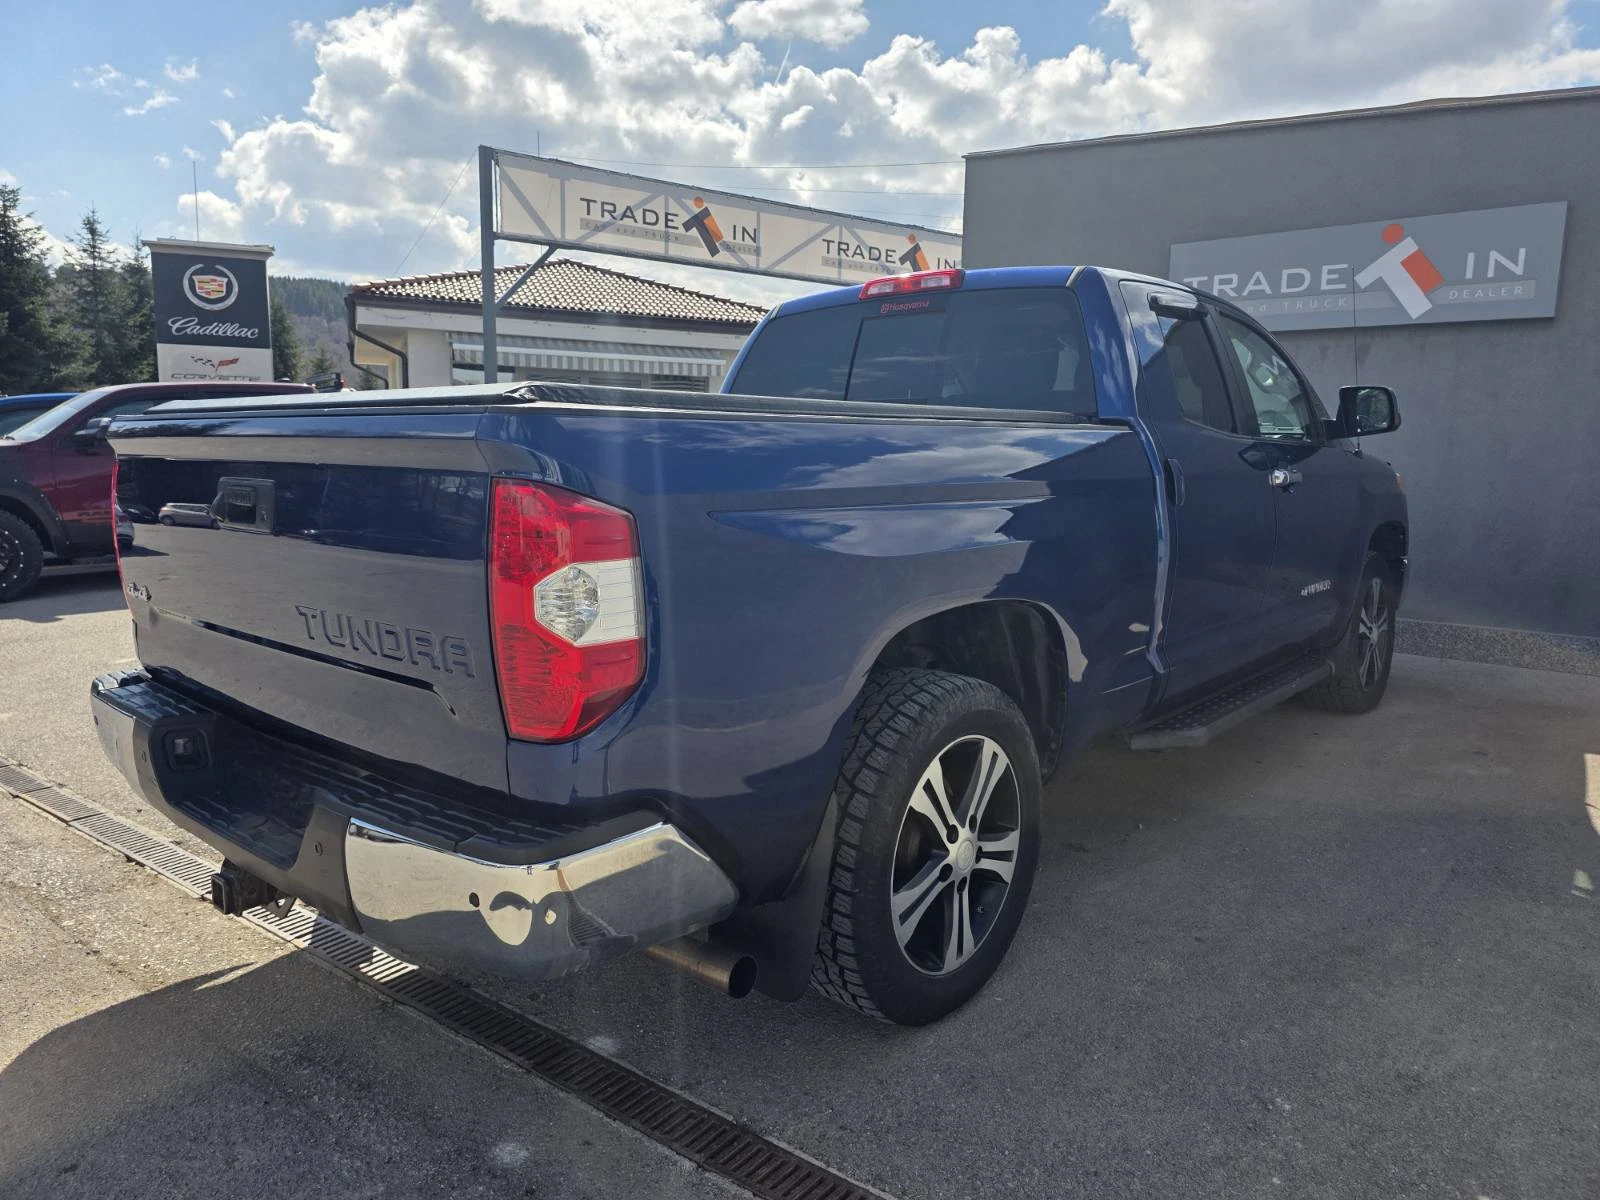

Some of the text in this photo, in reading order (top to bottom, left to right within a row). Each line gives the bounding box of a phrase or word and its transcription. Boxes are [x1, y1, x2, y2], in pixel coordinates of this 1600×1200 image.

[580, 197, 680, 230] TRADE
[732, 224, 757, 244] IN
[822, 238, 897, 264] TRADE
[937, 257, 956, 269] IN
[1184, 263, 1349, 298] TRADE
[1464, 247, 1527, 280] IN
[889, 300, 930, 313] Husqvarna
[1282, 296, 1348, 311] TRUCK
[1448, 285, 1524, 300] DEALER
[168, 316, 259, 339] Cadillac
[171, 372, 261, 382] CORVETTE
[295, 604, 475, 678] TUNDRA
